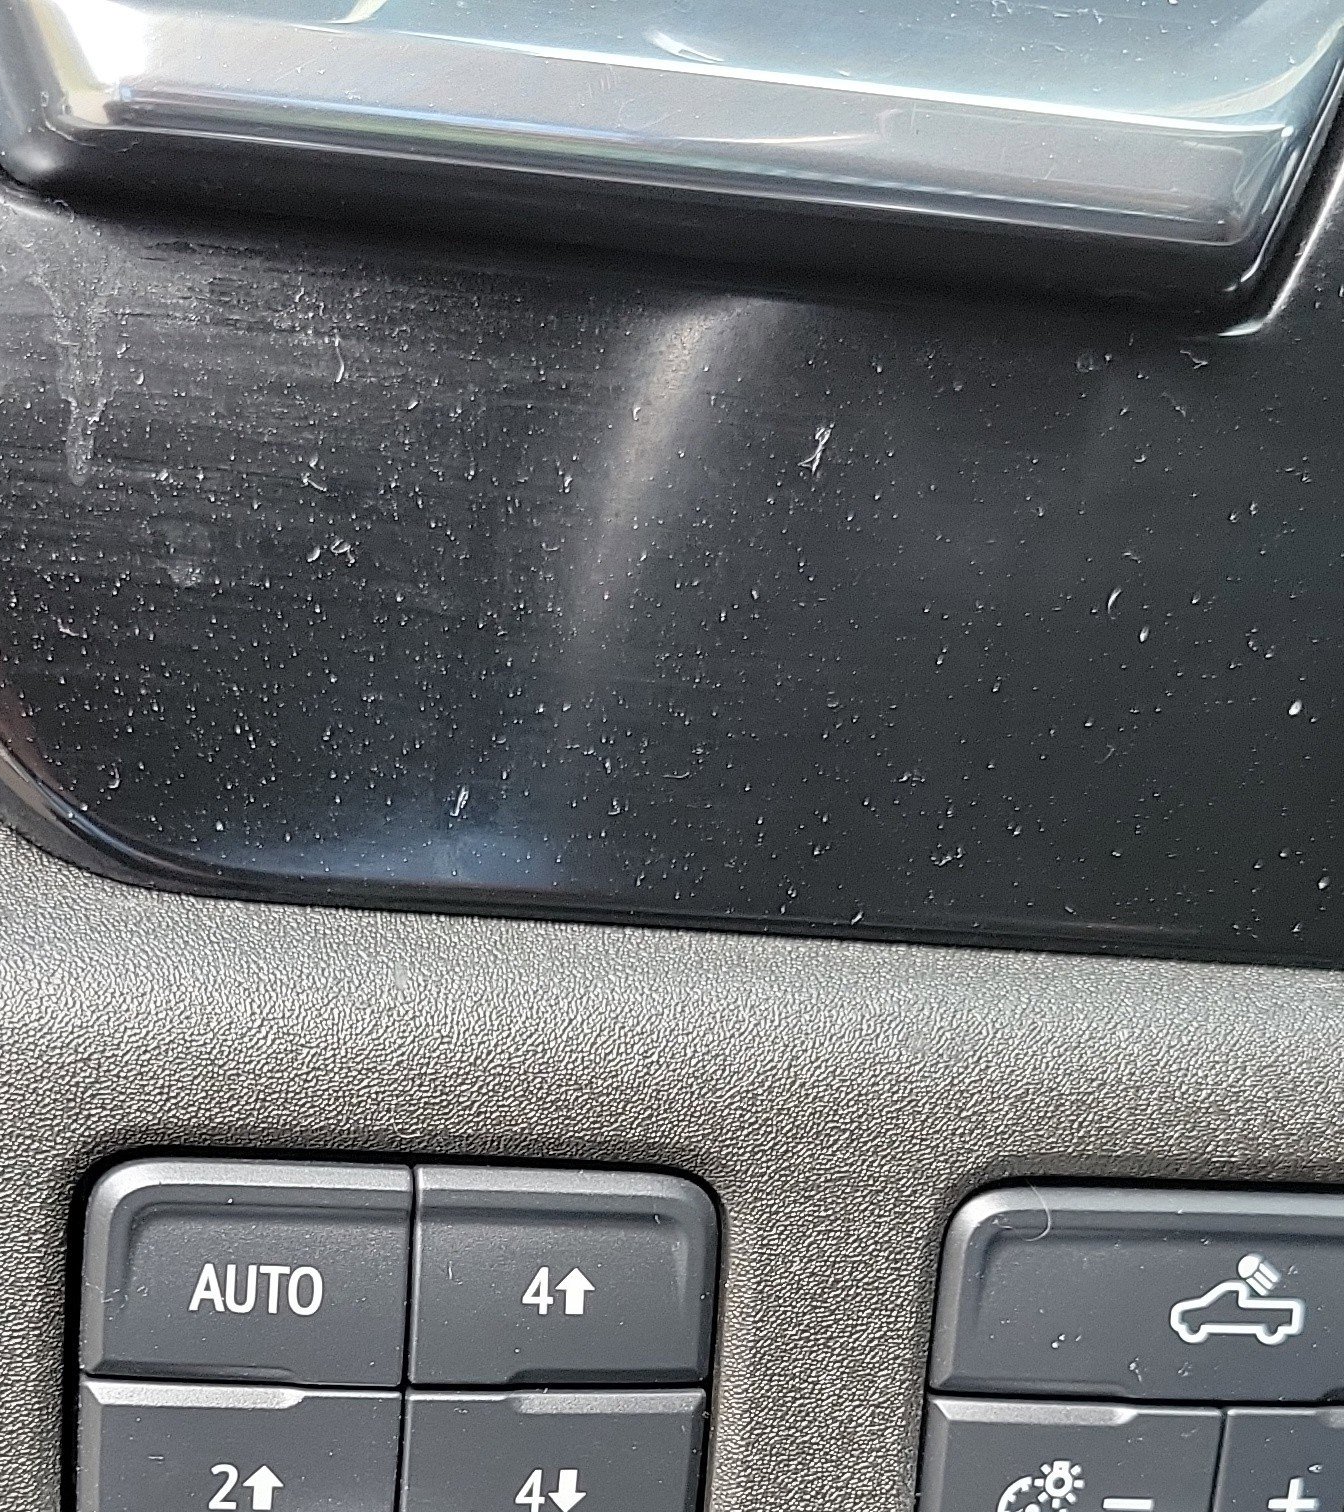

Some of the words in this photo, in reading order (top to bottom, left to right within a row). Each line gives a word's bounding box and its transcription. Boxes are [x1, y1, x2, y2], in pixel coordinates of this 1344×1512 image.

[188, 1264, 323, 1316] AUTO
[521, 1266, 554, 1315] 4
[208, 1463, 239, 1510] 2
